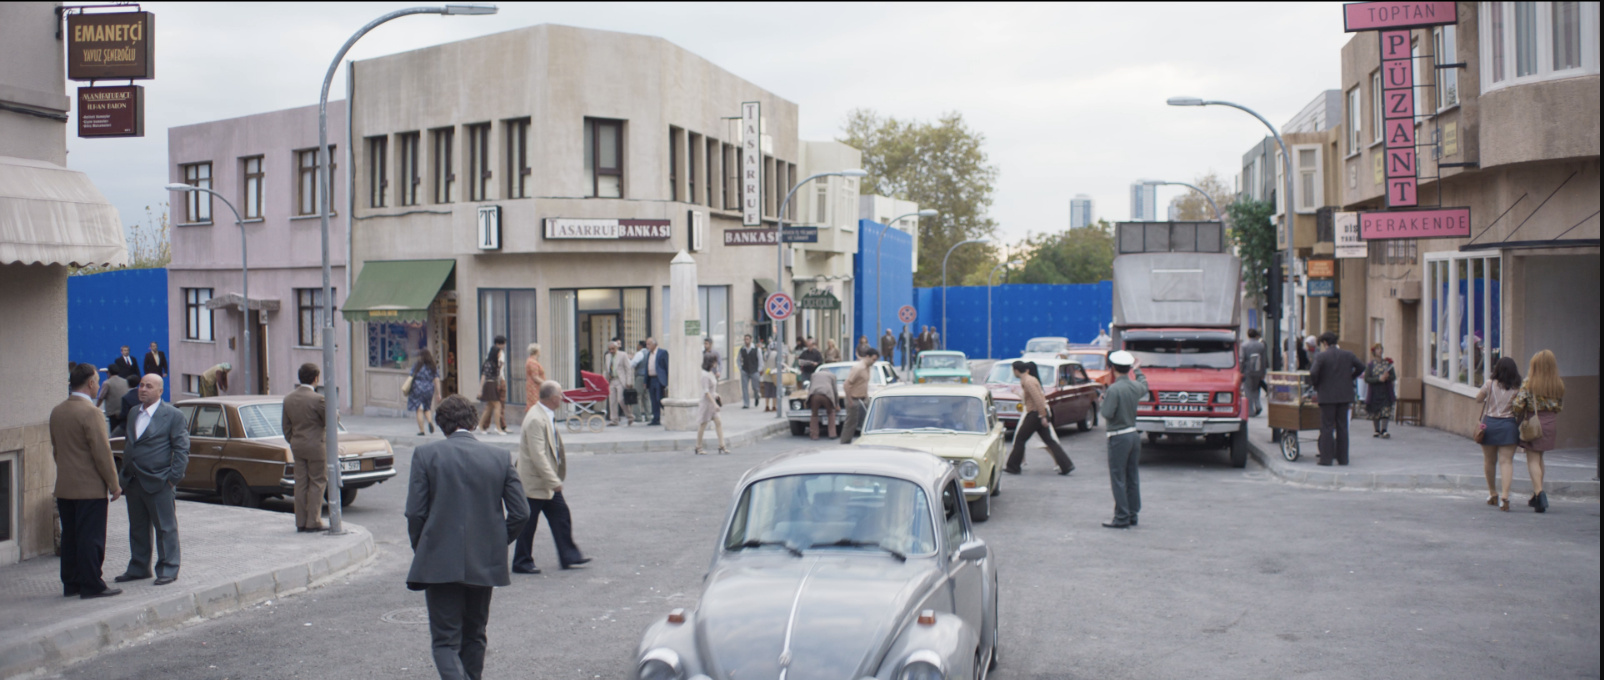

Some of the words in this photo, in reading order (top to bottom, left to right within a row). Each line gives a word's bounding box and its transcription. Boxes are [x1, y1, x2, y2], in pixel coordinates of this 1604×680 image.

[1368, 3, 1435, 22] TOPTAN
[75, 21, 142, 45] EMANETÇİ
[83, 49, 102, 62] YAVUZ
[1388, 34, 1412, 201] PÜZANT
[746, 105, 756, 223] TASARRUF
[479, 209, 496, 246] T
[549, 219, 617, 237] TASARRUF
[618, 225, 671, 237] BANKASI
[1364, 215, 1467, 233] PERAKENDE
